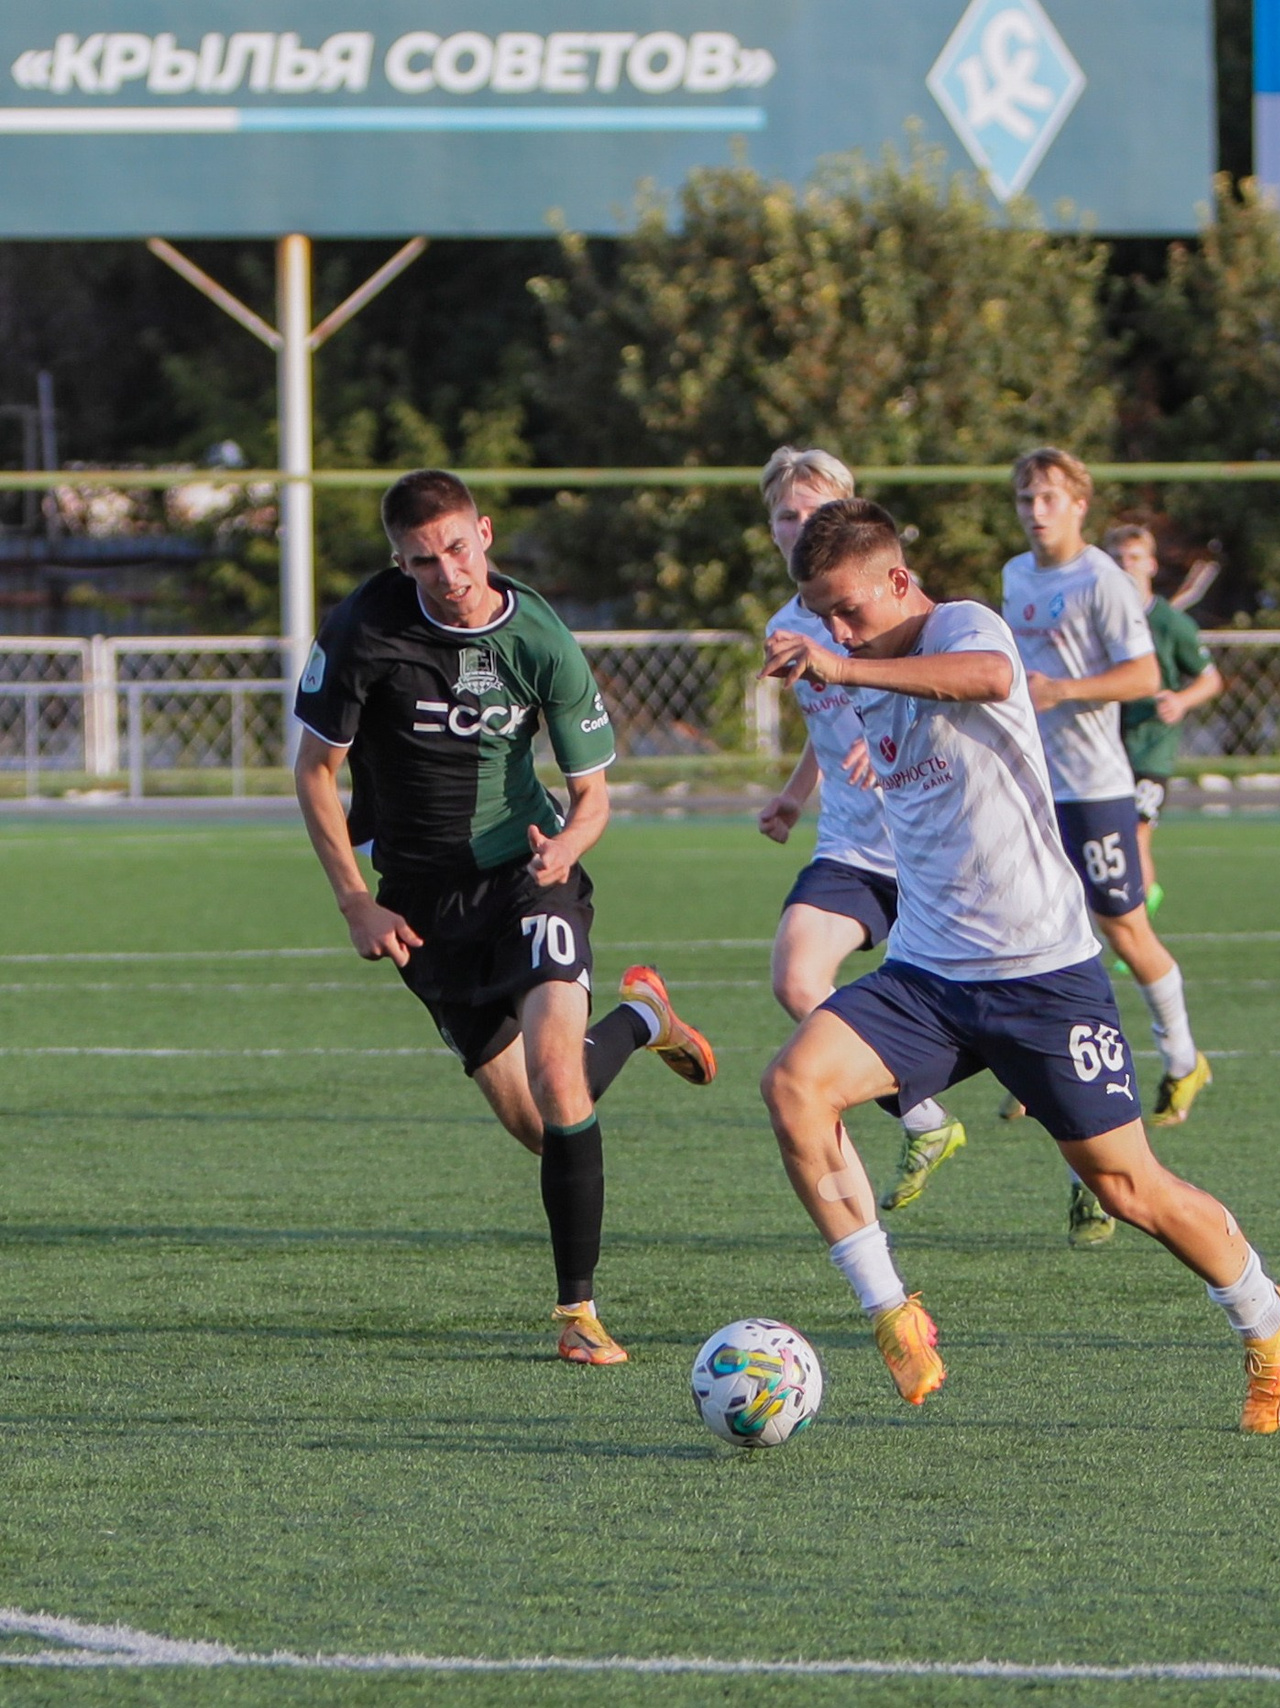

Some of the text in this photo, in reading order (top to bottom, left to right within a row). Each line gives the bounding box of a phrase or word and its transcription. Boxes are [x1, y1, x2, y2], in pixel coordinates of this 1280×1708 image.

[11, 32, 777, 94] «КРЫЛЬЯ СОВЕТОВ»
[580, 711, 609, 733] Cons
[922, 772, 954, 791] БАНК
[1083, 832, 1126, 885] 85
[521, 914, 575, 969] 70
